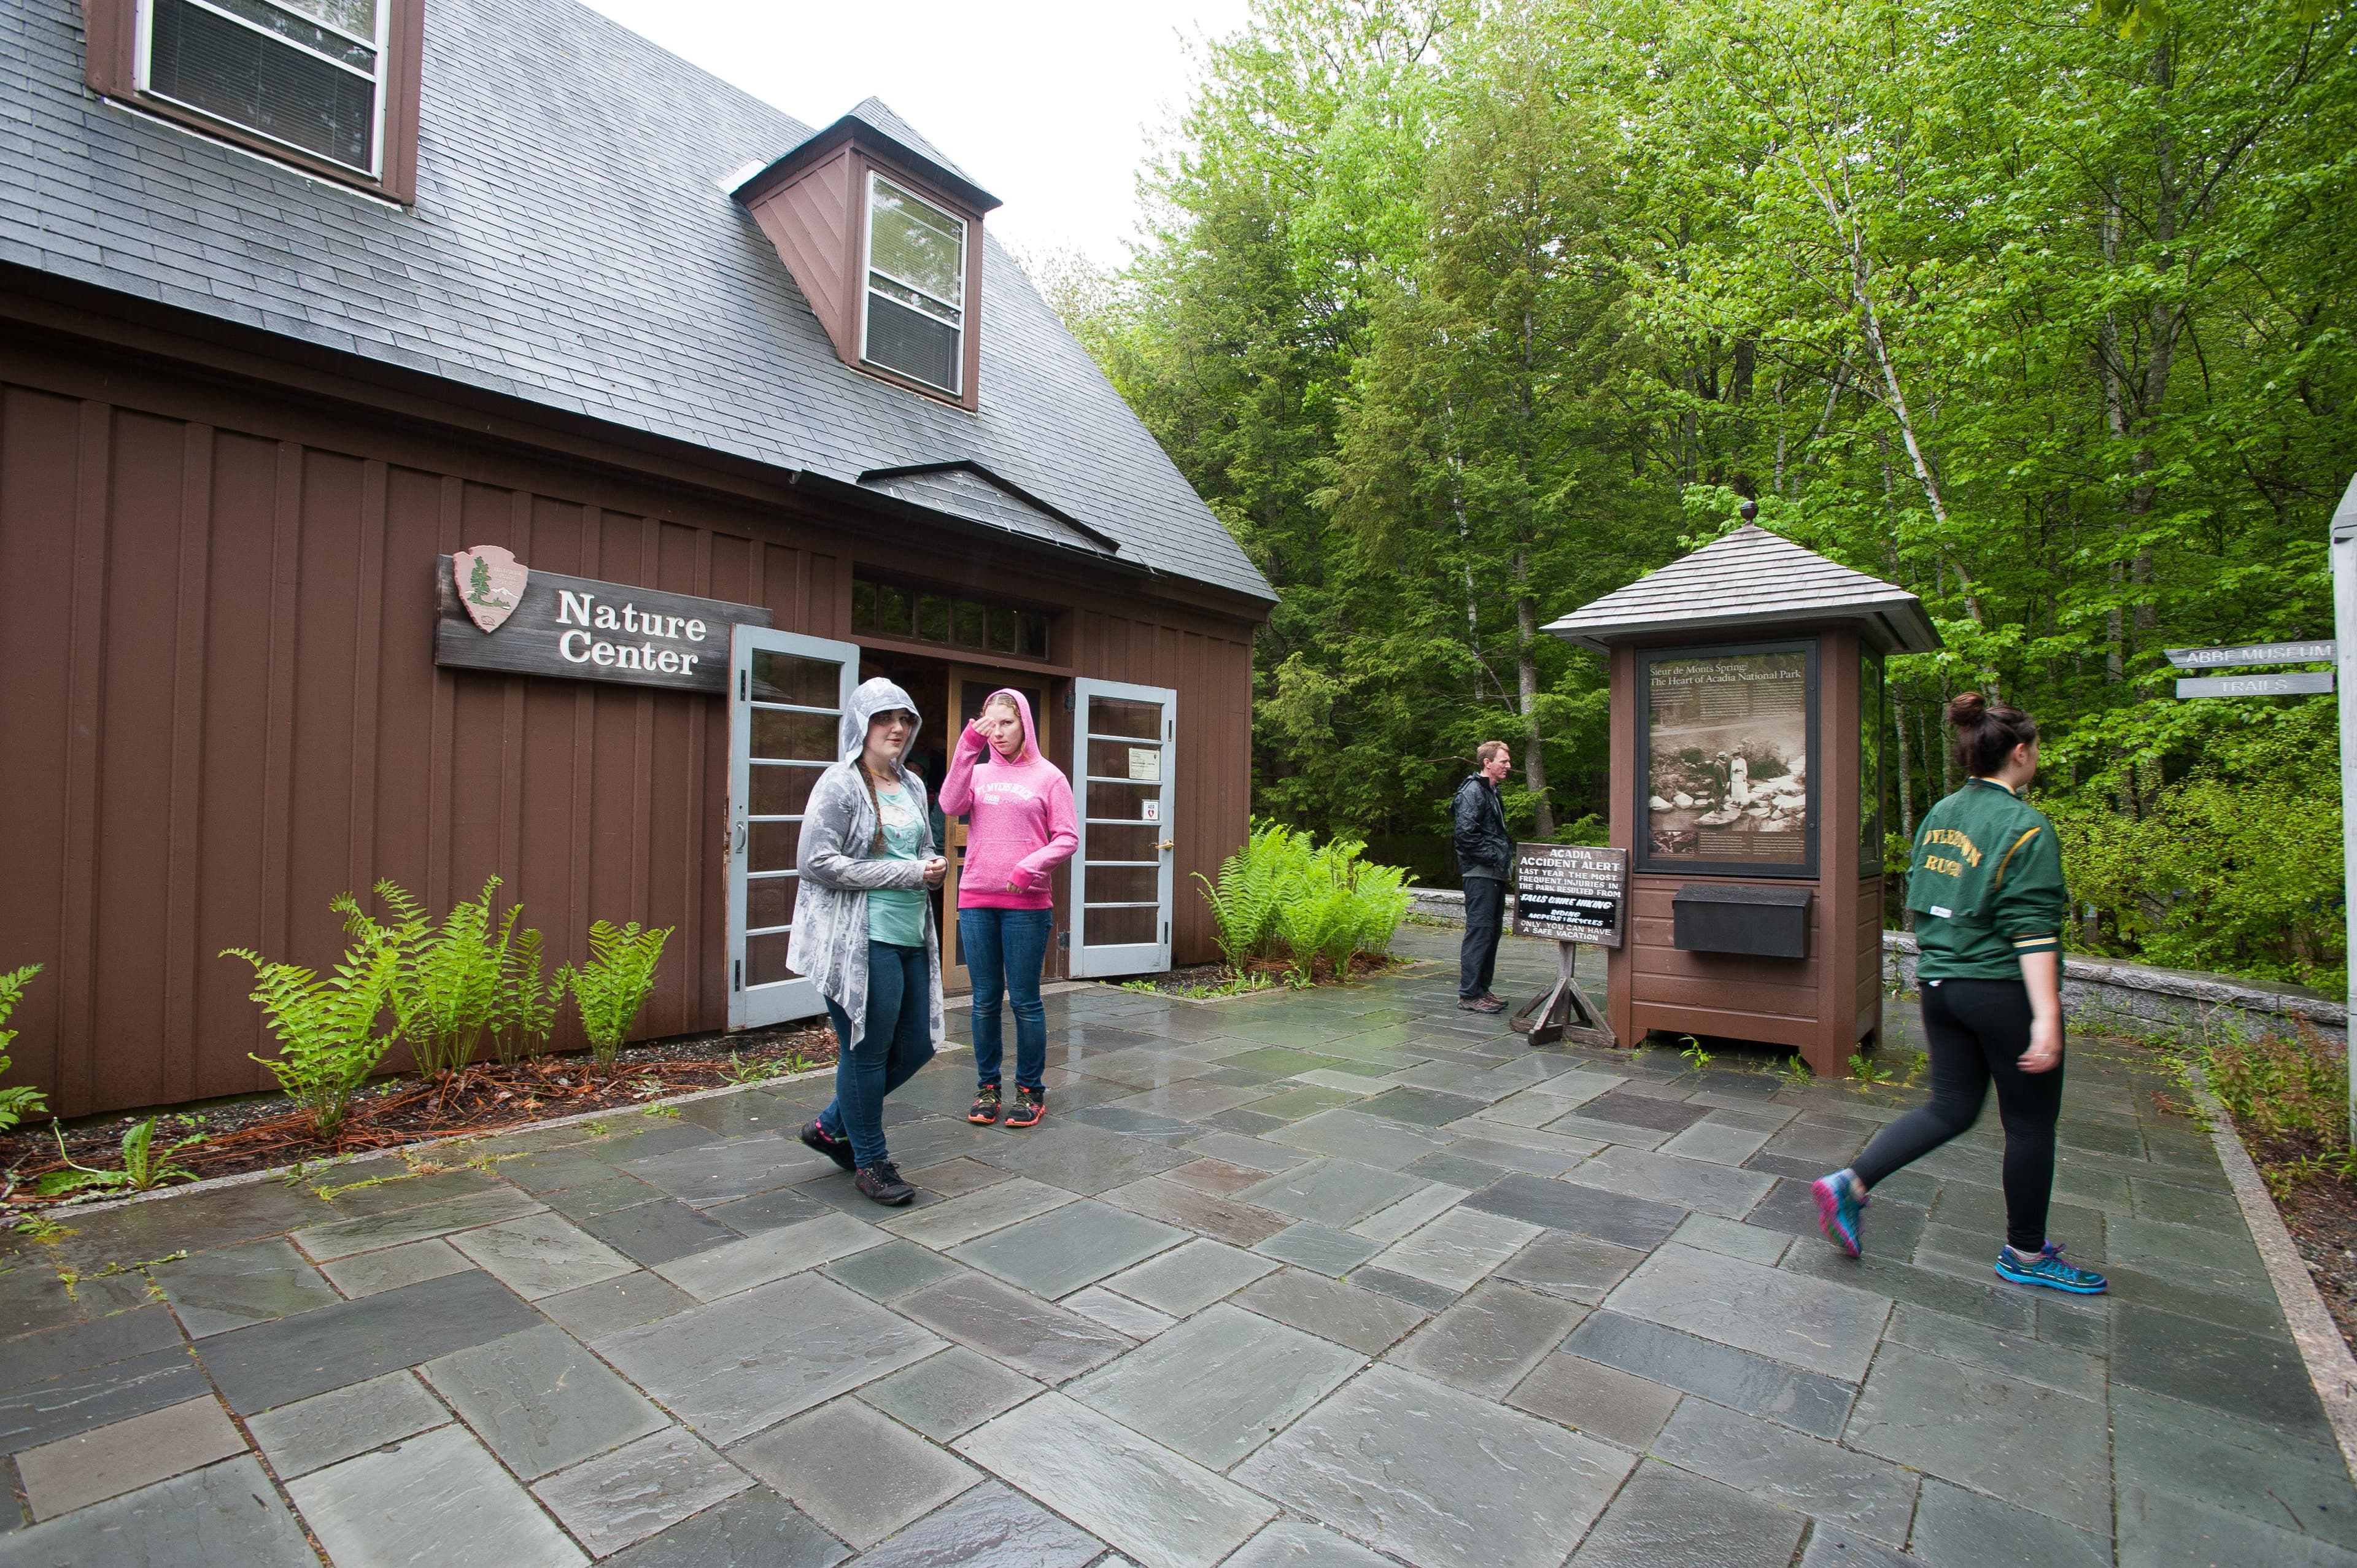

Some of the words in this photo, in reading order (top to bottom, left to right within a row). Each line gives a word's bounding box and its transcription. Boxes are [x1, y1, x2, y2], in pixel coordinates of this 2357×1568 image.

[555, 590, 707, 641] Nature
[559, 628, 699, 676] Center
[2186, 650, 2235, 663] ABBE
[2242, 645, 2331, 660] MUSEUM
[1668, 676, 1692, 685] Heart
[1706, 674, 1736, 683] Acadia
[1738, 671, 1778, 681] National
[1780, 670, 1801, 678] Park
[2219, 679, 2288, 692] TRAILS
[1549, 849, 1592, 859] ACADIA
[1520, 857, 1577, 868] ACCIDENT
[1581, 861, 1620, 871] ALERT
[1519, 876, 1562, 884] FREQUENT
[1565, 879, 1604, 888] INJURIES
[1557, 886, 1593, 895] RESULTED
[1520, 894, 1547, 903] FALLS
[1548, 897, 1576, 906] WHILE
[1576, 899, 1612, 909] HIKING
[1528, 913, 1562, 922] MOPEDS
[1566, 917, 1604, 926] BICYCLES
[1556, 930, 1598, 941] VACATION
